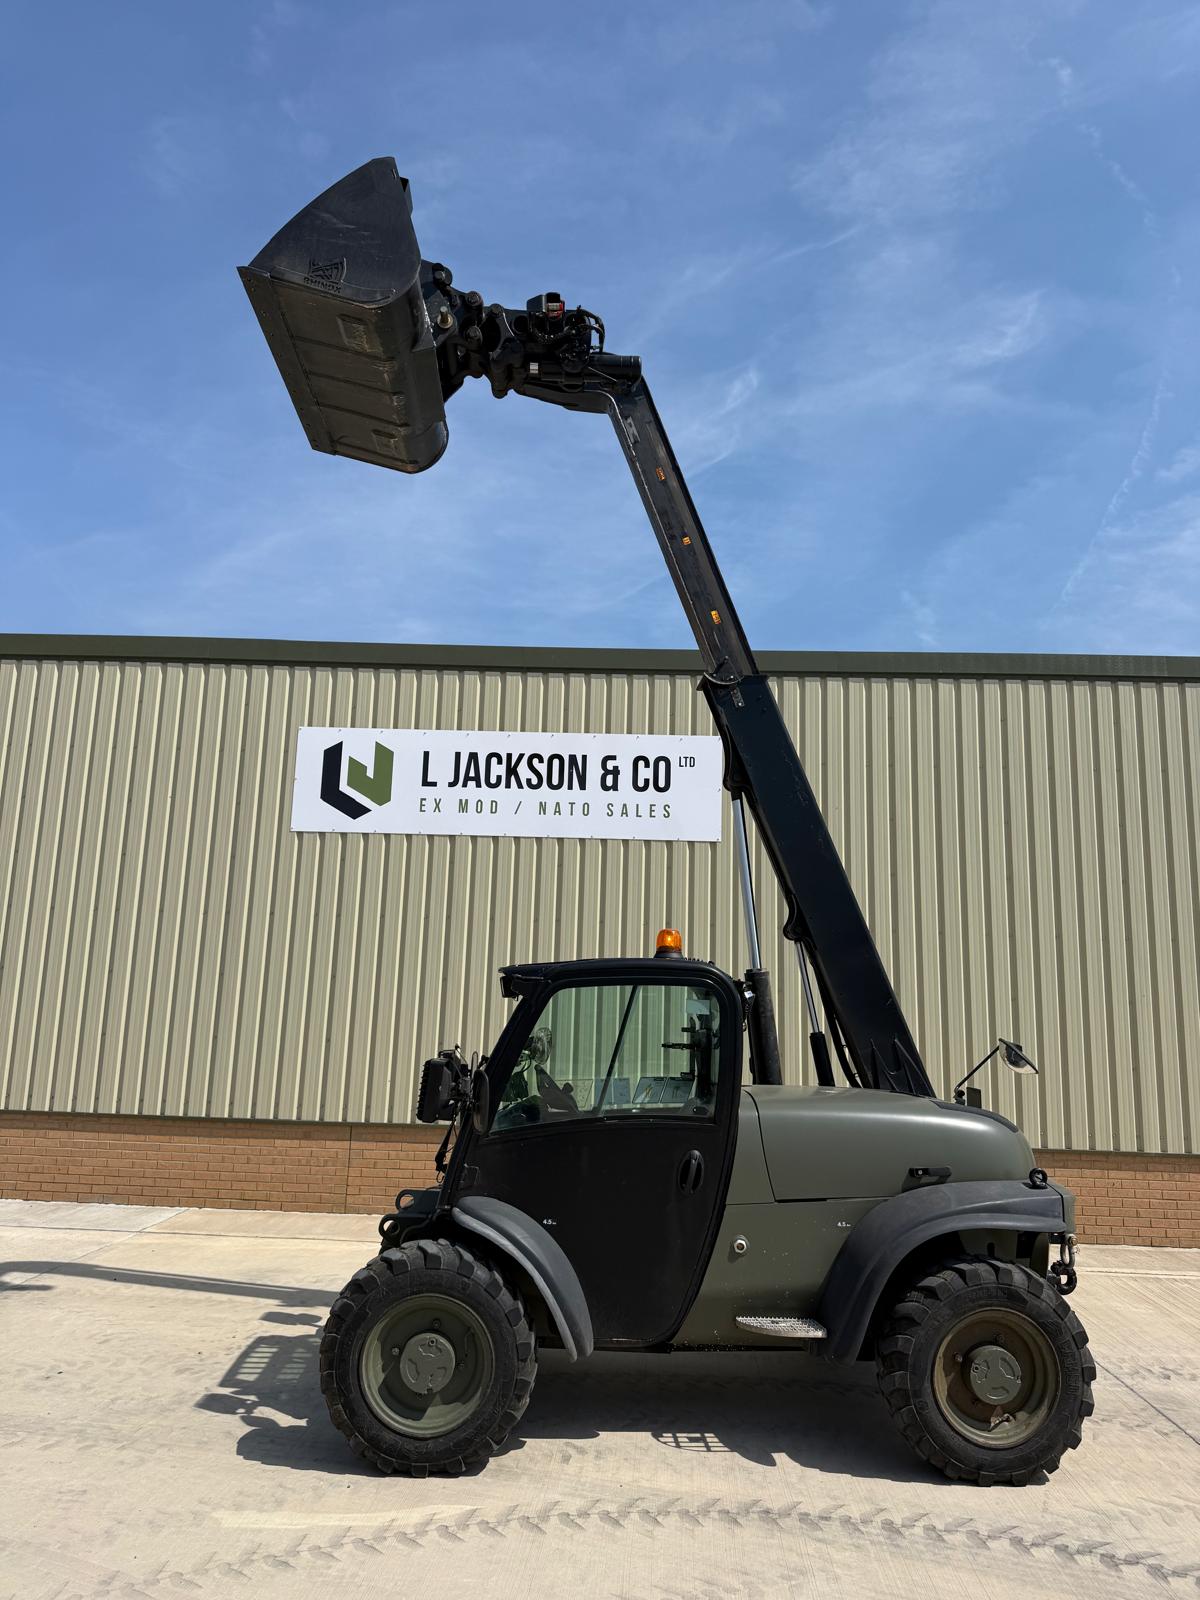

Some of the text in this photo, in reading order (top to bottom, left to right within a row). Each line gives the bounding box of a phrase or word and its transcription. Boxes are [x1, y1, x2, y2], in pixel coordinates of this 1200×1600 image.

[421, 750, 696, 794] L JACKSON & CO LTD
[419, 797, 442, 813] EX
[458, 798, 498, 815] MOD
[538, 801, 590, 817] NATO
[606, 802, 671, 819] SALES
